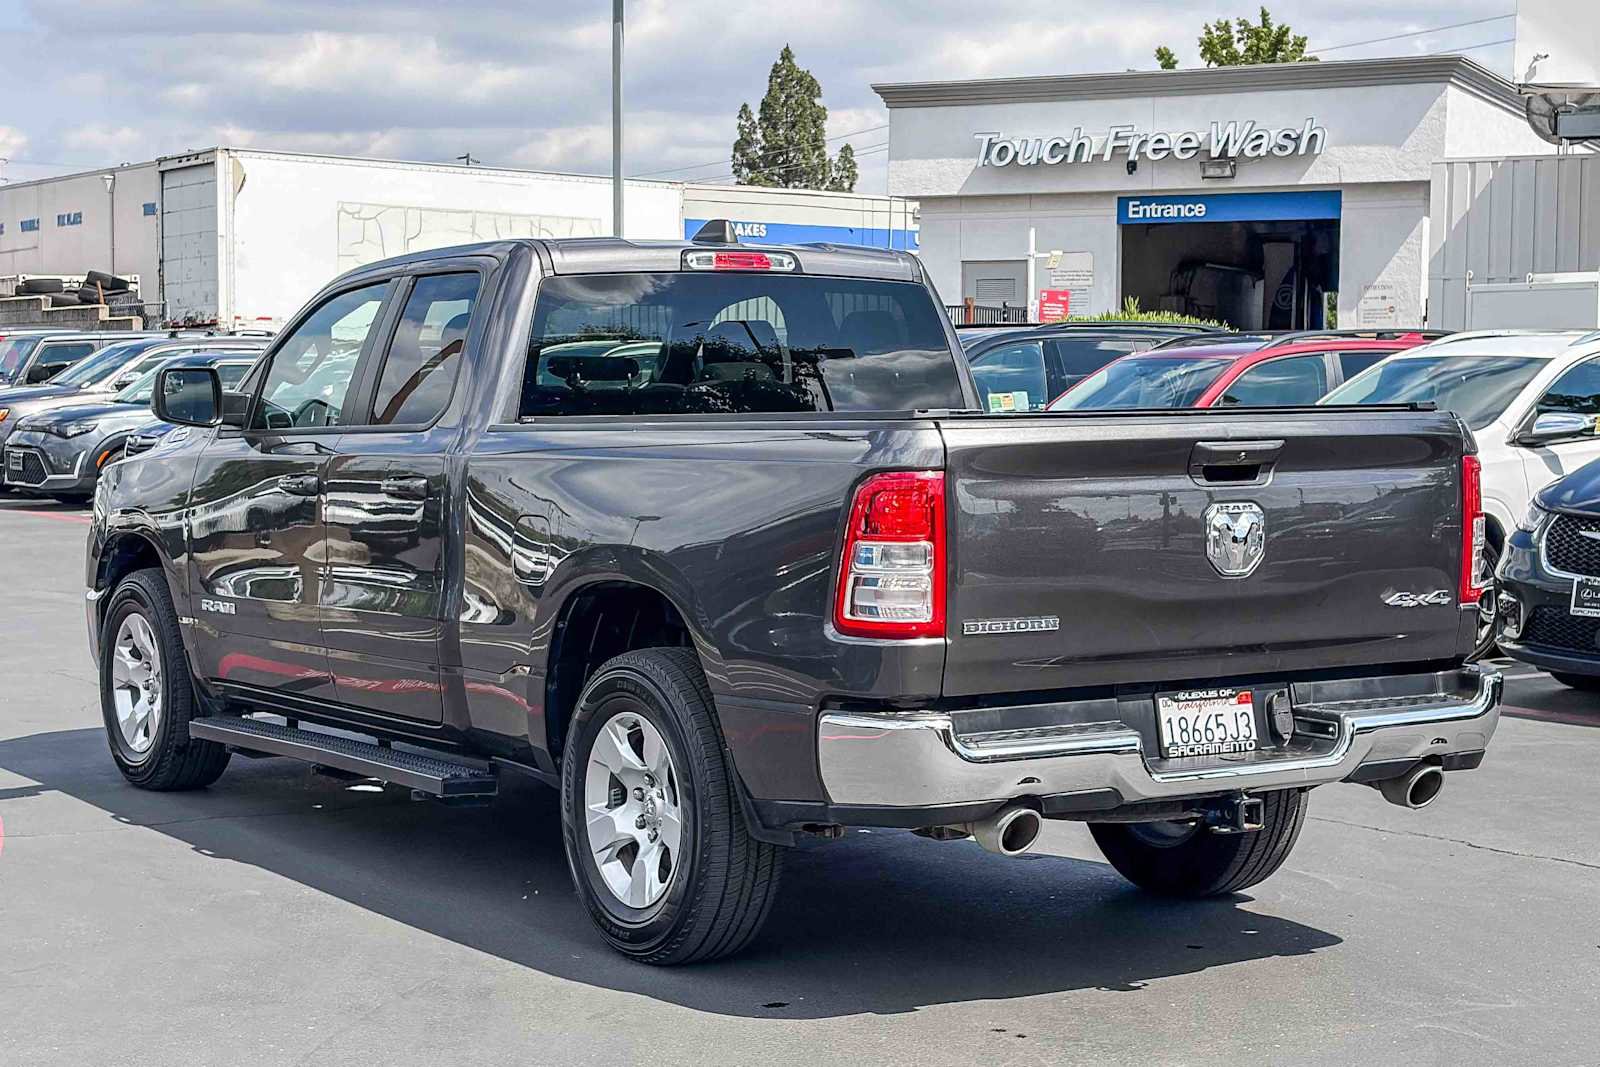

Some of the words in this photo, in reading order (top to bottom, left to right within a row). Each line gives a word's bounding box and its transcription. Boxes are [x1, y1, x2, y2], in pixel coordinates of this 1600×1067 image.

[974, 127, 1093, 168] Touch
[1103, 124, 1201, 162] Free
[1209, 117, 1327, 159] Wash
[1127, 200, 1207, 220] Entrance
[731, 222, 767, 237] AKES
[1218, 504, 1254, 512] RAM
[201, 599, 236, 615] RAM
[962, 617, 1060, 635] BIGHORN
[1185, 689, 1218, 700] LEXUS
[1219, 688, 1233, 698] OF
[1166, 711, 1253, 746] 18665J3
[1168, 740, 1256, 758] SACRAMENTO
